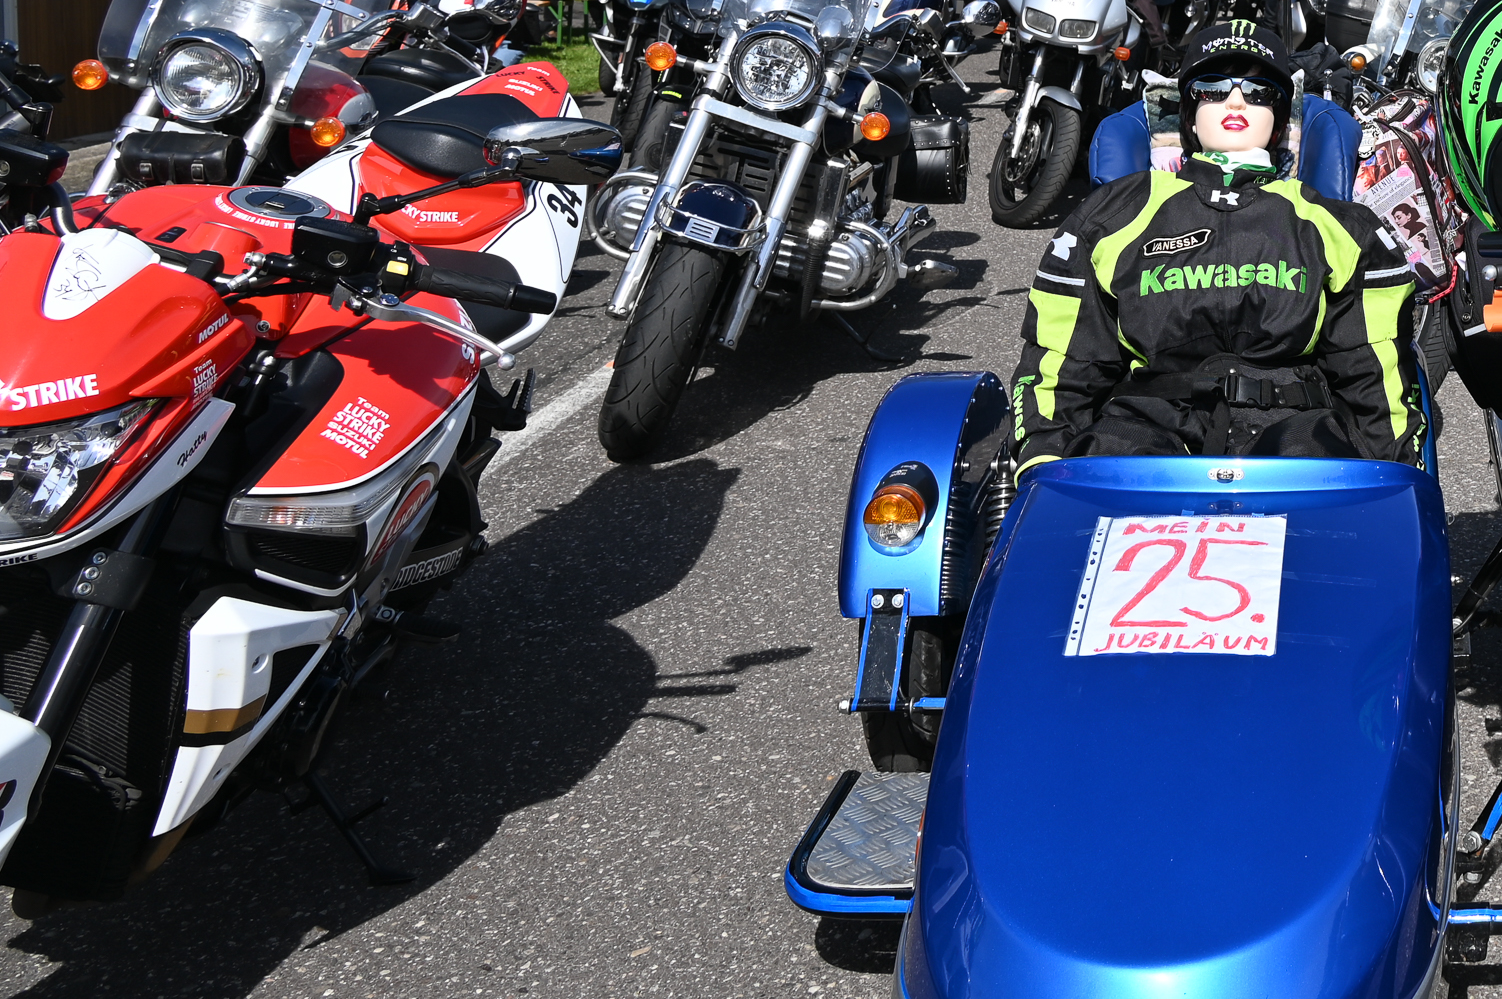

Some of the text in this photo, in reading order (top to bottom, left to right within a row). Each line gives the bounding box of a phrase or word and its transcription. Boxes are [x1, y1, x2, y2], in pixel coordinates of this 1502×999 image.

[1202, 35, 1275, 60] MONSTER
[1209, 44, 1267, 57] ENERGY
[504, 84, 536, 97] MOTUL
[508, 78, 543, 92] SUZUKI
[1371, 174, 1395, 195] AVENUE
[419, 210, 459, 223] STRIKE
[546, 183, 583, 229] 34
[1152, 235, 1199, 252] VANESSA
[1140, 260, 1307, 297] Kawasaki
[198, 313, 229, 344] MOTUL
[193, 359, 213, 374] Team
[193, 364, 217, 387] LUCKY
[11, 373, 100, 412] STRIKE
[193, 373, 219, 398] STRIKE
[343, 402, 391, 433] LUCKY
[357, 396, 390, 420] Team
[1012, 374, 1036, 441] Kawas
[327, 421, 376, 451] SUZUKI
[333, 411, 385, 444] STRIKE
[320, 429, 370, 459] MOTUL
[1122, 518, 1246, 536] MEIN
[1109, 537, 1269, 628] 25.
[1093, 631, 1270, 652] JUBILÄUM
